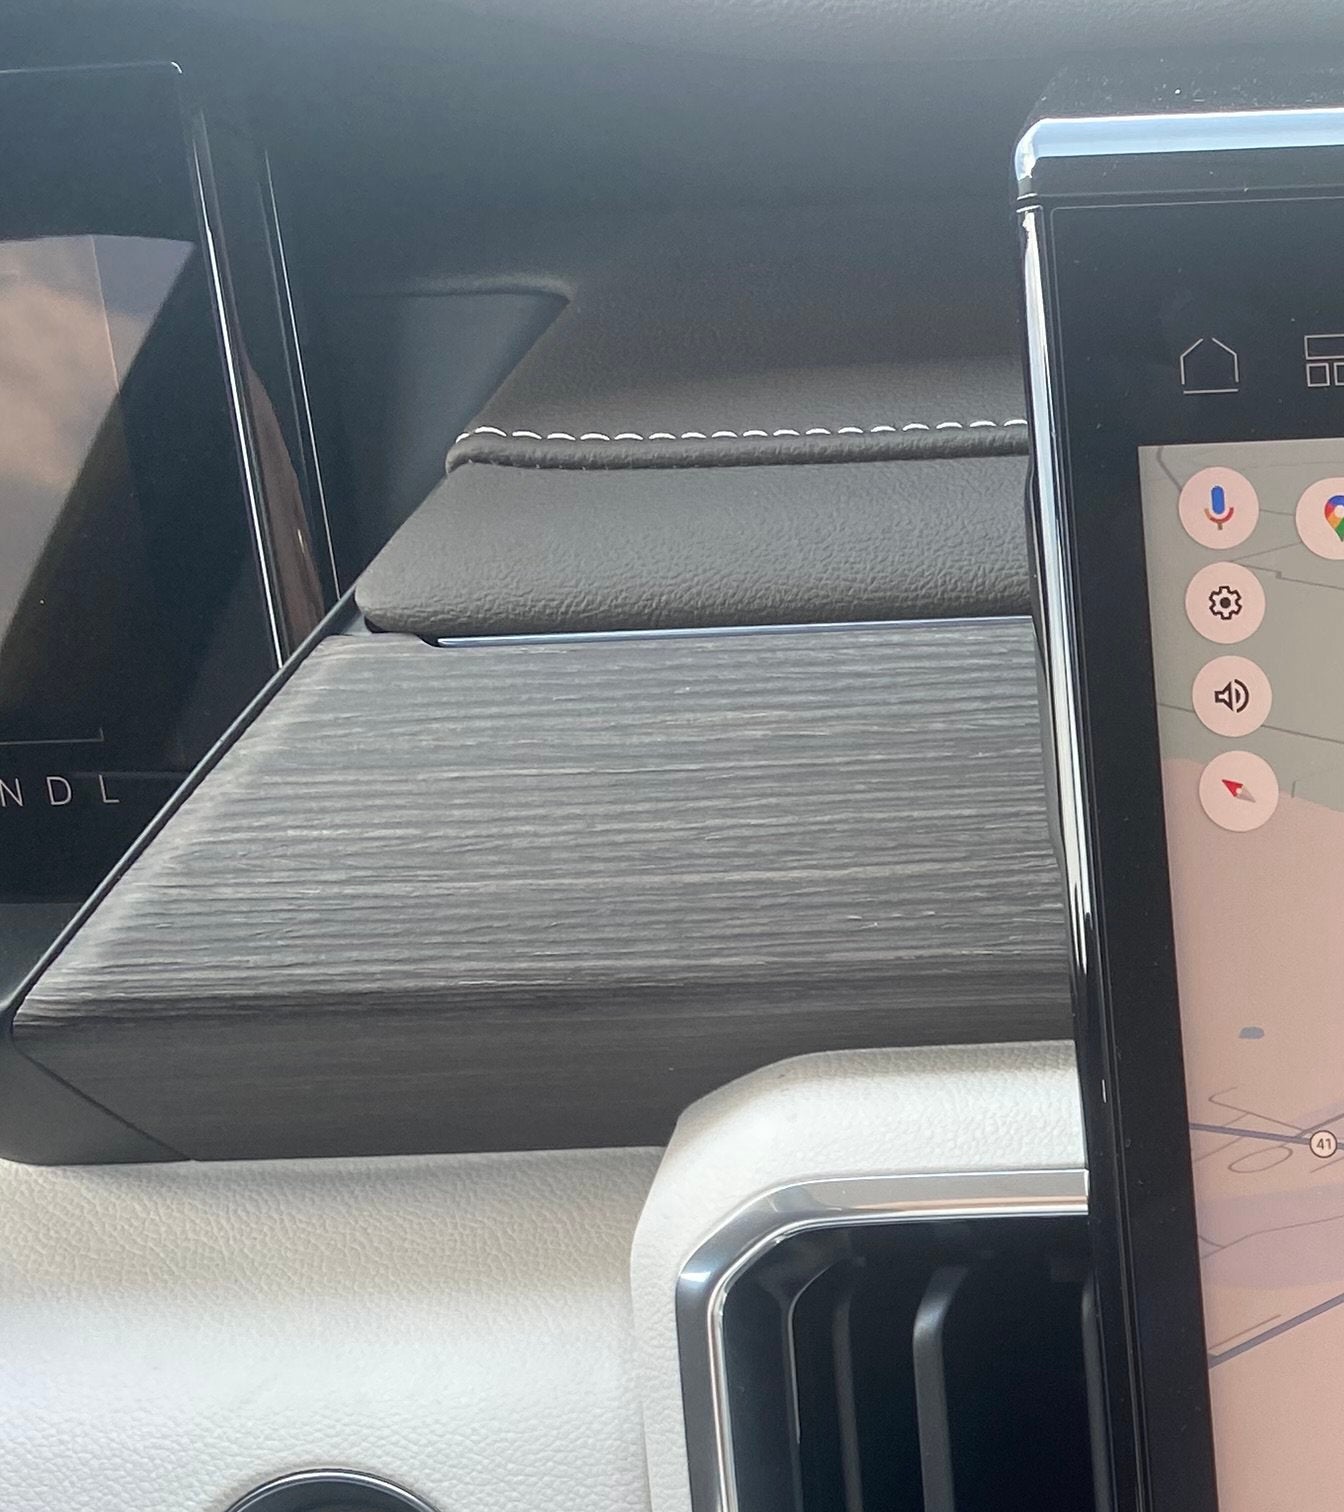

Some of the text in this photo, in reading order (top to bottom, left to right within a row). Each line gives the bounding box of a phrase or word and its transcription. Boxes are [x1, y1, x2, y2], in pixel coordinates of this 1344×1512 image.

[0, 773, 120, 807] N D L
[1316, 1138, 1332, 1151] 41
